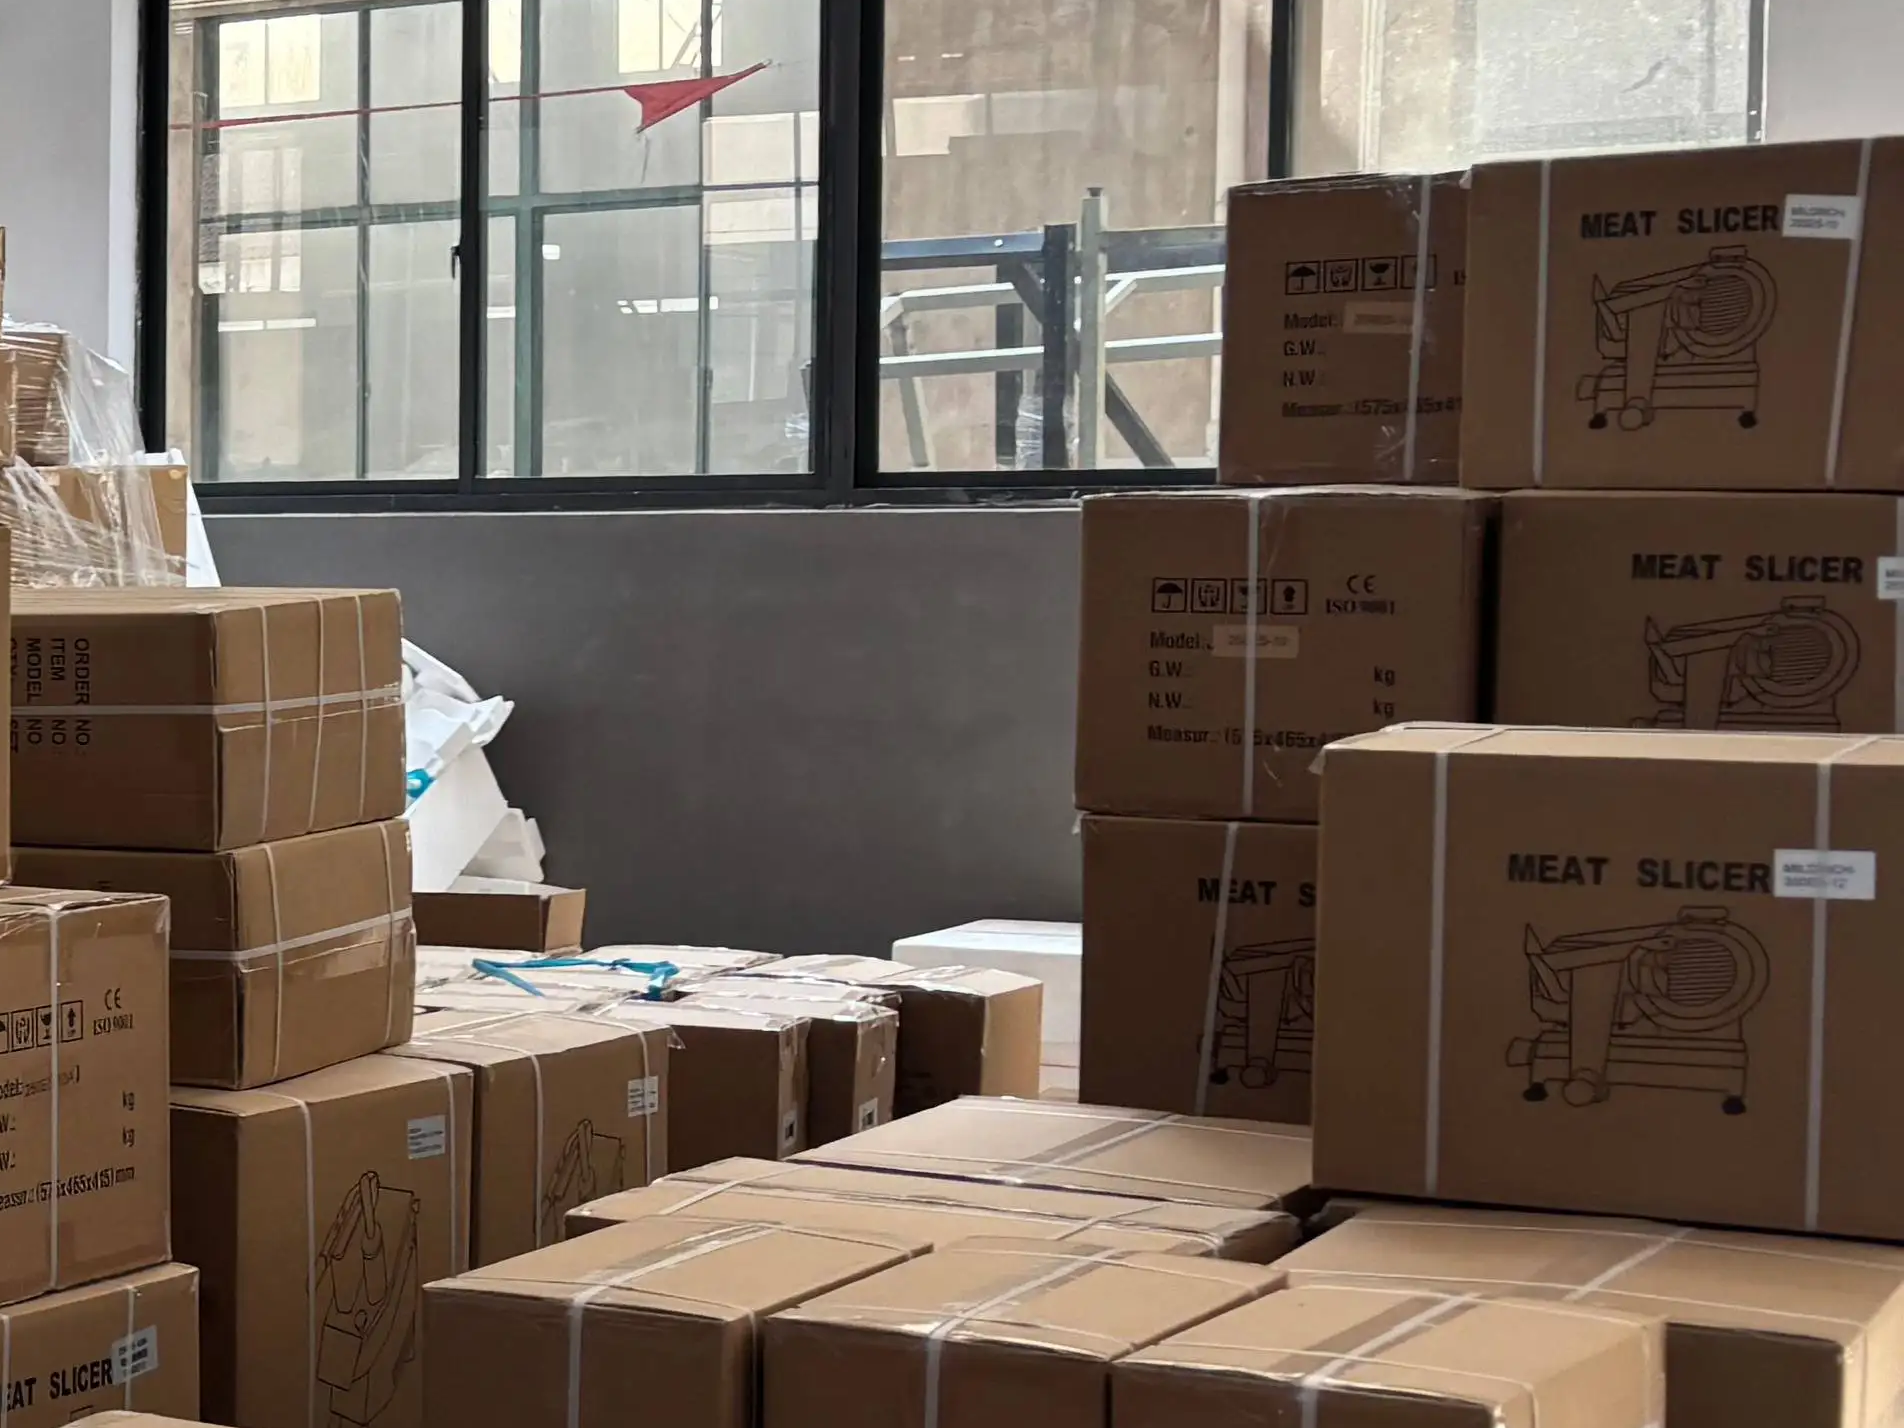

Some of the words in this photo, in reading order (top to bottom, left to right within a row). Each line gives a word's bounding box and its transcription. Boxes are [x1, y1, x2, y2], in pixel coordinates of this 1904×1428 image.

[1581, 210, 1657, 238] MEAT
[1677, 205, 1779, 234] SLICER
[1631, 553, 1722, 581] MEAT
[1745, 554, 1864, 583] SLICER
[26, 638, 42, 702] MODEL
[50, 638, 66, 681] ITEM
[74, 638, 90, 705] ORDER
[1373, 666, 1395, 686] kg
[1373, 698, 1394, 717] kg
[1508, 854, 1609, 886] MEAT
[1637, 858, 1772, 893] SLICER
[122, 1090, 135, 1112] kg
[122, 1127, 135, 1148] kg
[50, 1358, 113, 1400] SLICER
